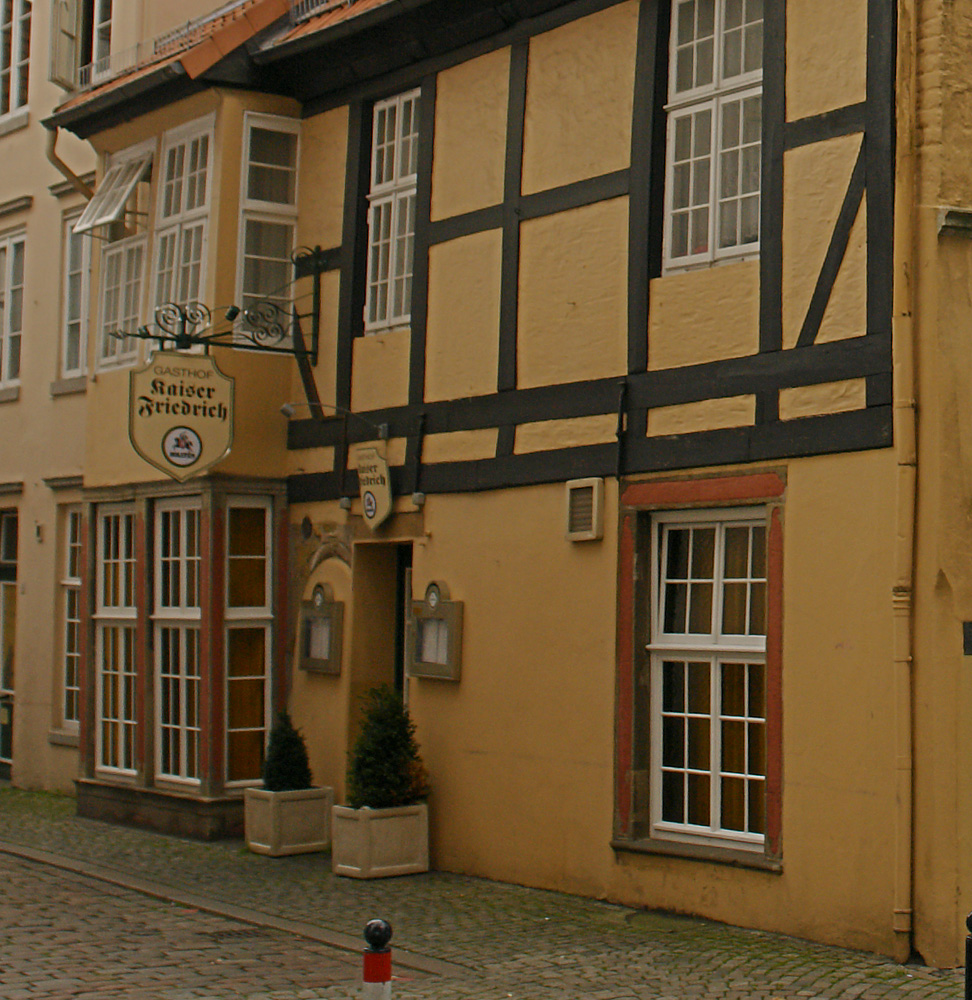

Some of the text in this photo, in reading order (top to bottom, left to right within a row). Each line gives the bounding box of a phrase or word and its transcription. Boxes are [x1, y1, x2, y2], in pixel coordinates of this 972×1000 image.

[153, 365, 214, 379] GASTHOF
[150, 378, 216, 399] Kaiser
[138, 395, 228, 422] Friedrich
